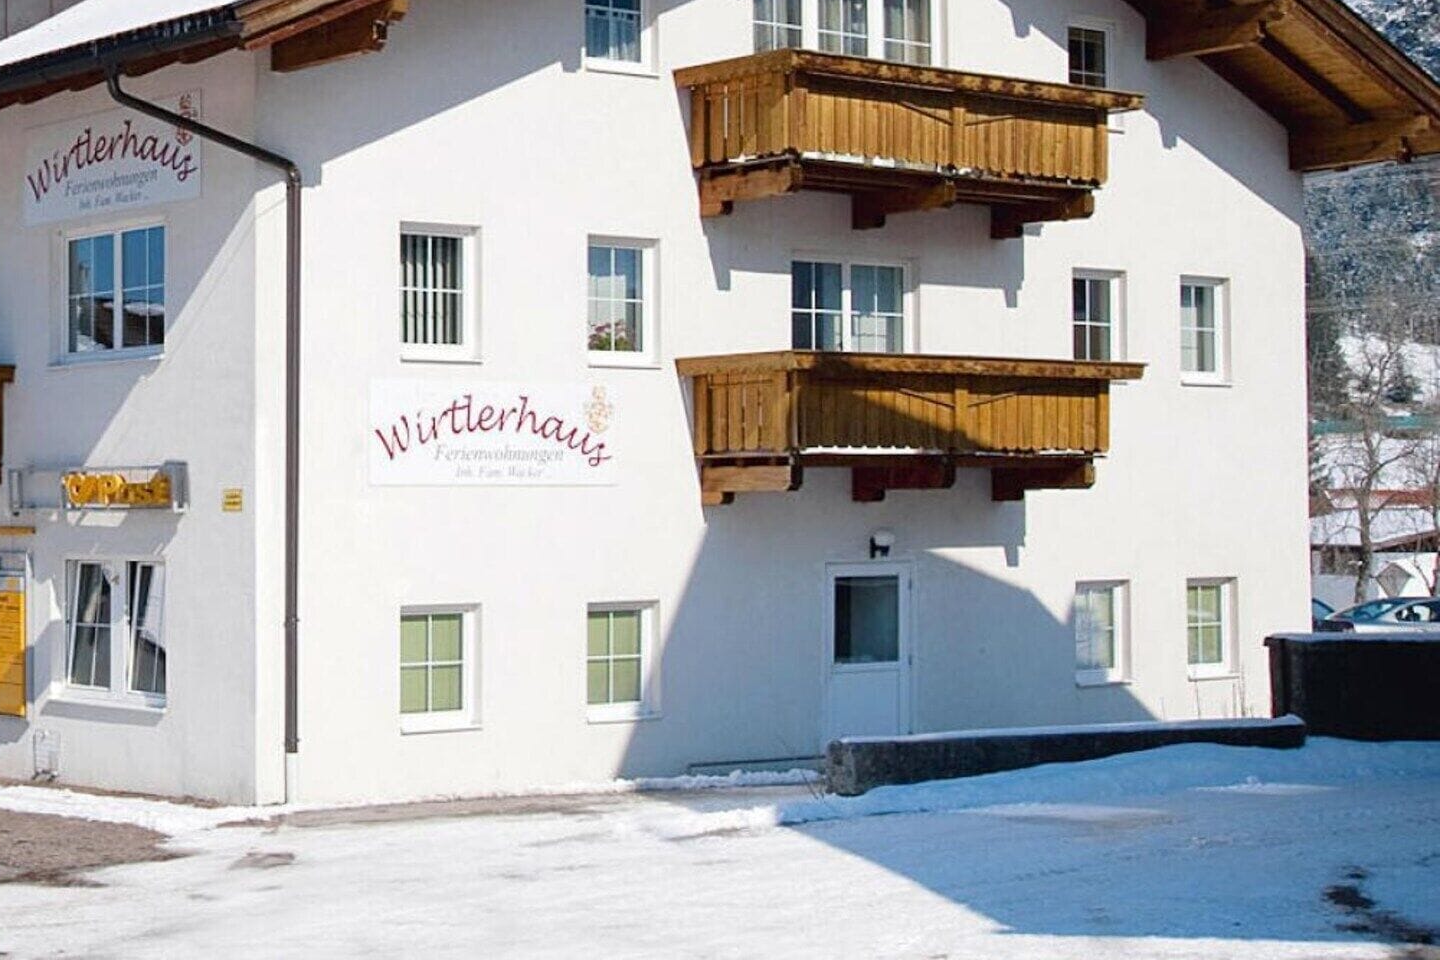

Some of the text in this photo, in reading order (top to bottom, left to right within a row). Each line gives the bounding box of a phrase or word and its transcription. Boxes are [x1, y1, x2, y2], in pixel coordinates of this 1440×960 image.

[27, 119, 198, 202] Wirtlerhaus
[375, 394, 612, 467] Wirtlerhaus
[434, 443, 564, 464] Ferienwohnungen
